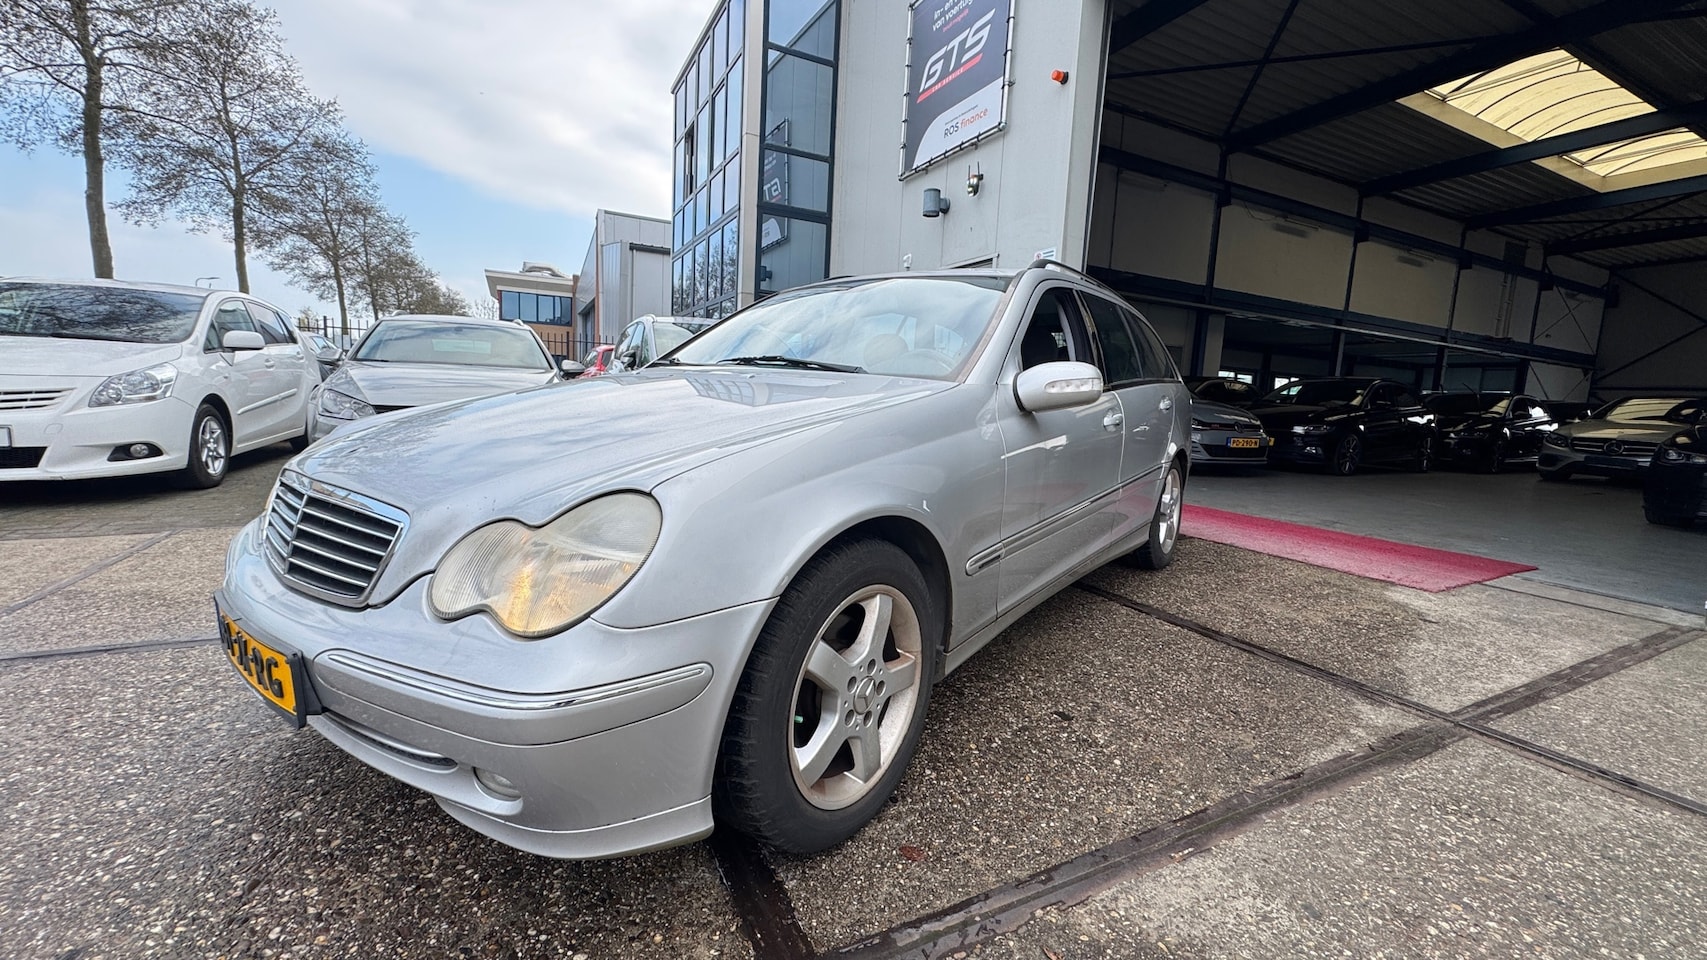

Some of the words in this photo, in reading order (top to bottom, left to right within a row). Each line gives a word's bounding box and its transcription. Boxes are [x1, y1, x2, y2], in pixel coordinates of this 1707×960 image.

[932, 16, 945, 32] van
[919, 8, 996, 93] GTS
[943, 121, 959, 139] ROS
[960, 107, 988, 129] finance
